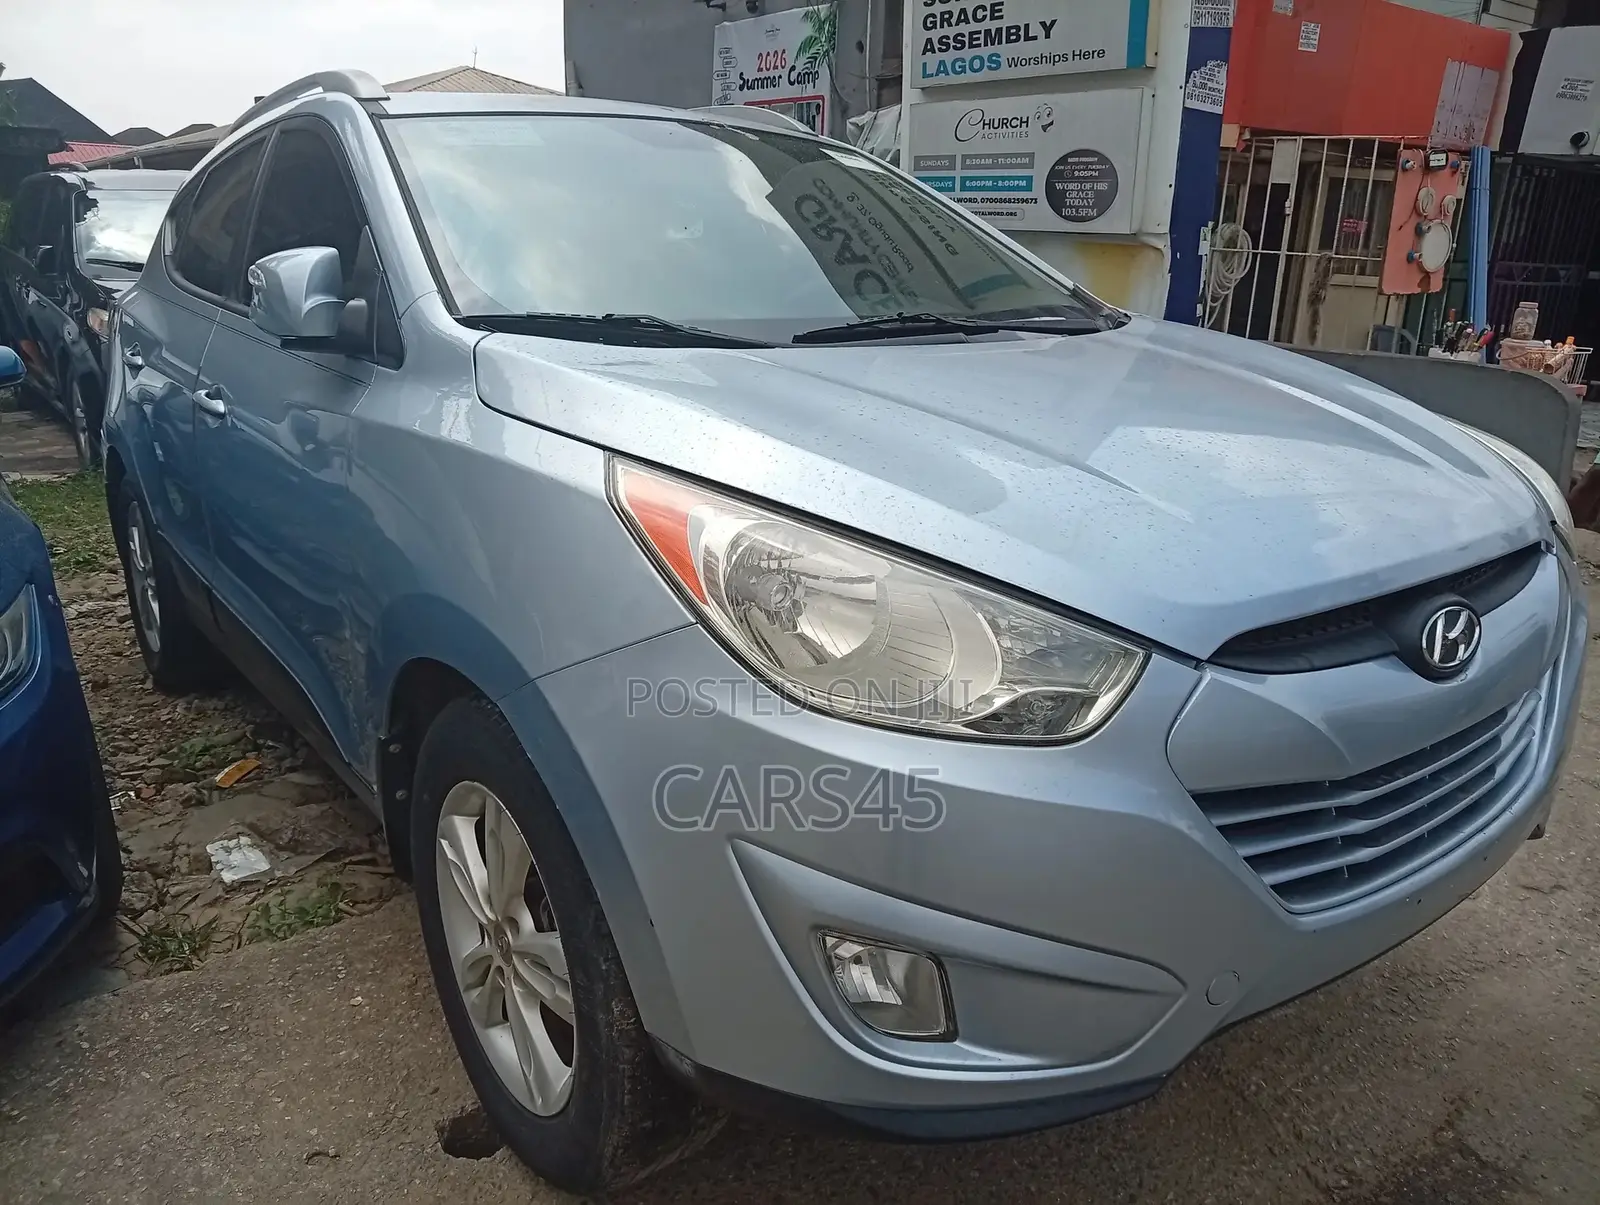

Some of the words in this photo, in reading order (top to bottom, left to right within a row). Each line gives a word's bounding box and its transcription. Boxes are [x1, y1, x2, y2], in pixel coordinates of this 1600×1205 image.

[922, 2, 1005, 31] GRACE
[921, 19, 1058, 55] ASSEMBLY
[921, 53, 1001, 79] LAGOS
[1006, 52, 1069, 68] Worships
[1072, 49, 1106, 61] Here
[738, 72, 782, 91] Summer
[787, 65, 820, 89] Camp
[954, 108, 1030, 142] CHURCH
[981, 131, 1029, 140] ACTIVITIES
[1094, 182, 1108, 190] HIS
[1062, 208, 1097, 217] 103.5FM
